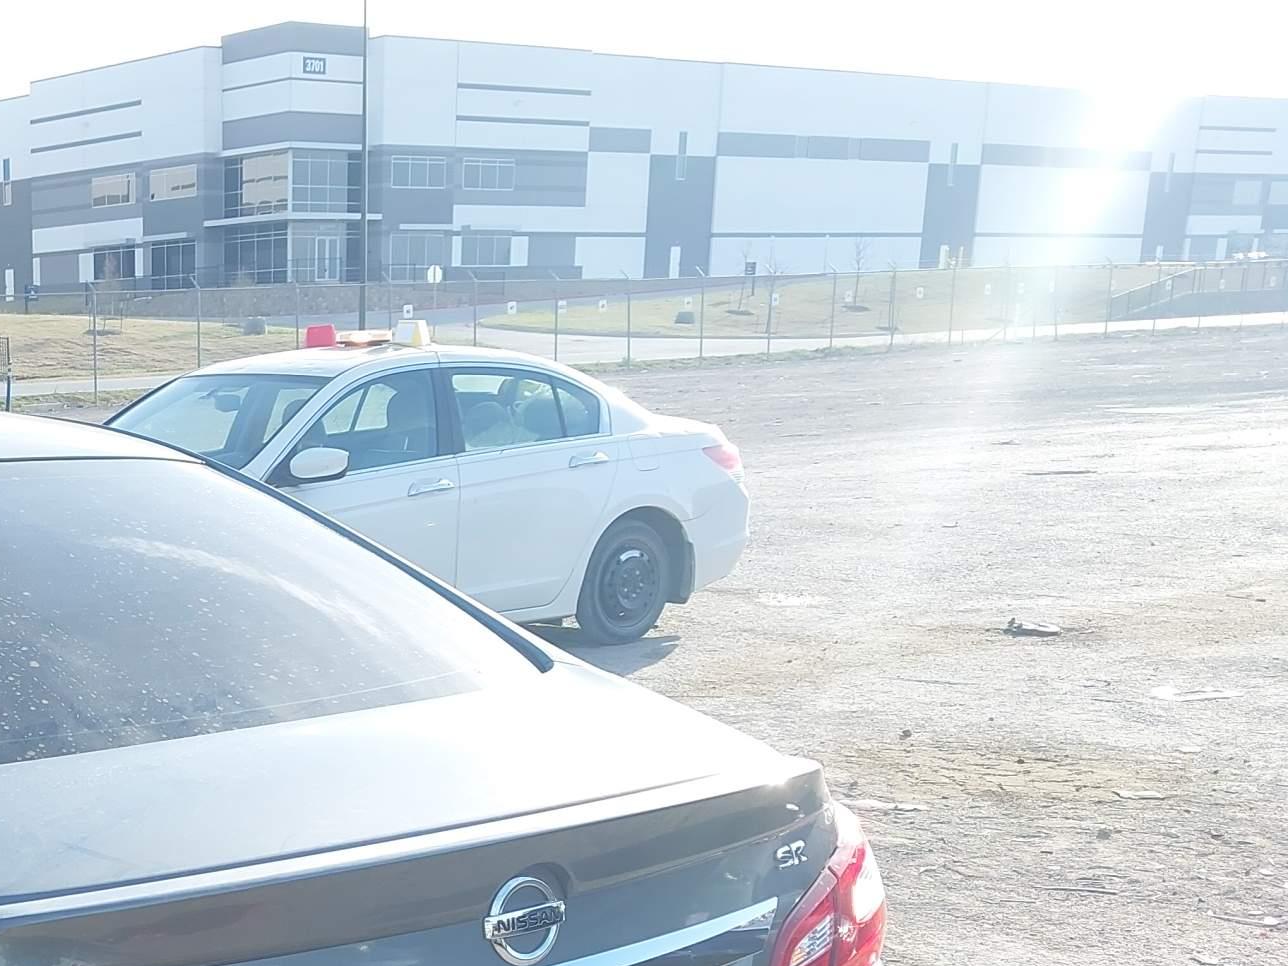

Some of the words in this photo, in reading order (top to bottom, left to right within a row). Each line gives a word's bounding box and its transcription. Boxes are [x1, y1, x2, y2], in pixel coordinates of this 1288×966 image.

[305, 59, 324, 72] 3701
[776, 840, 808, 870] SR
[496, 904, 562, 934] NISSAN
